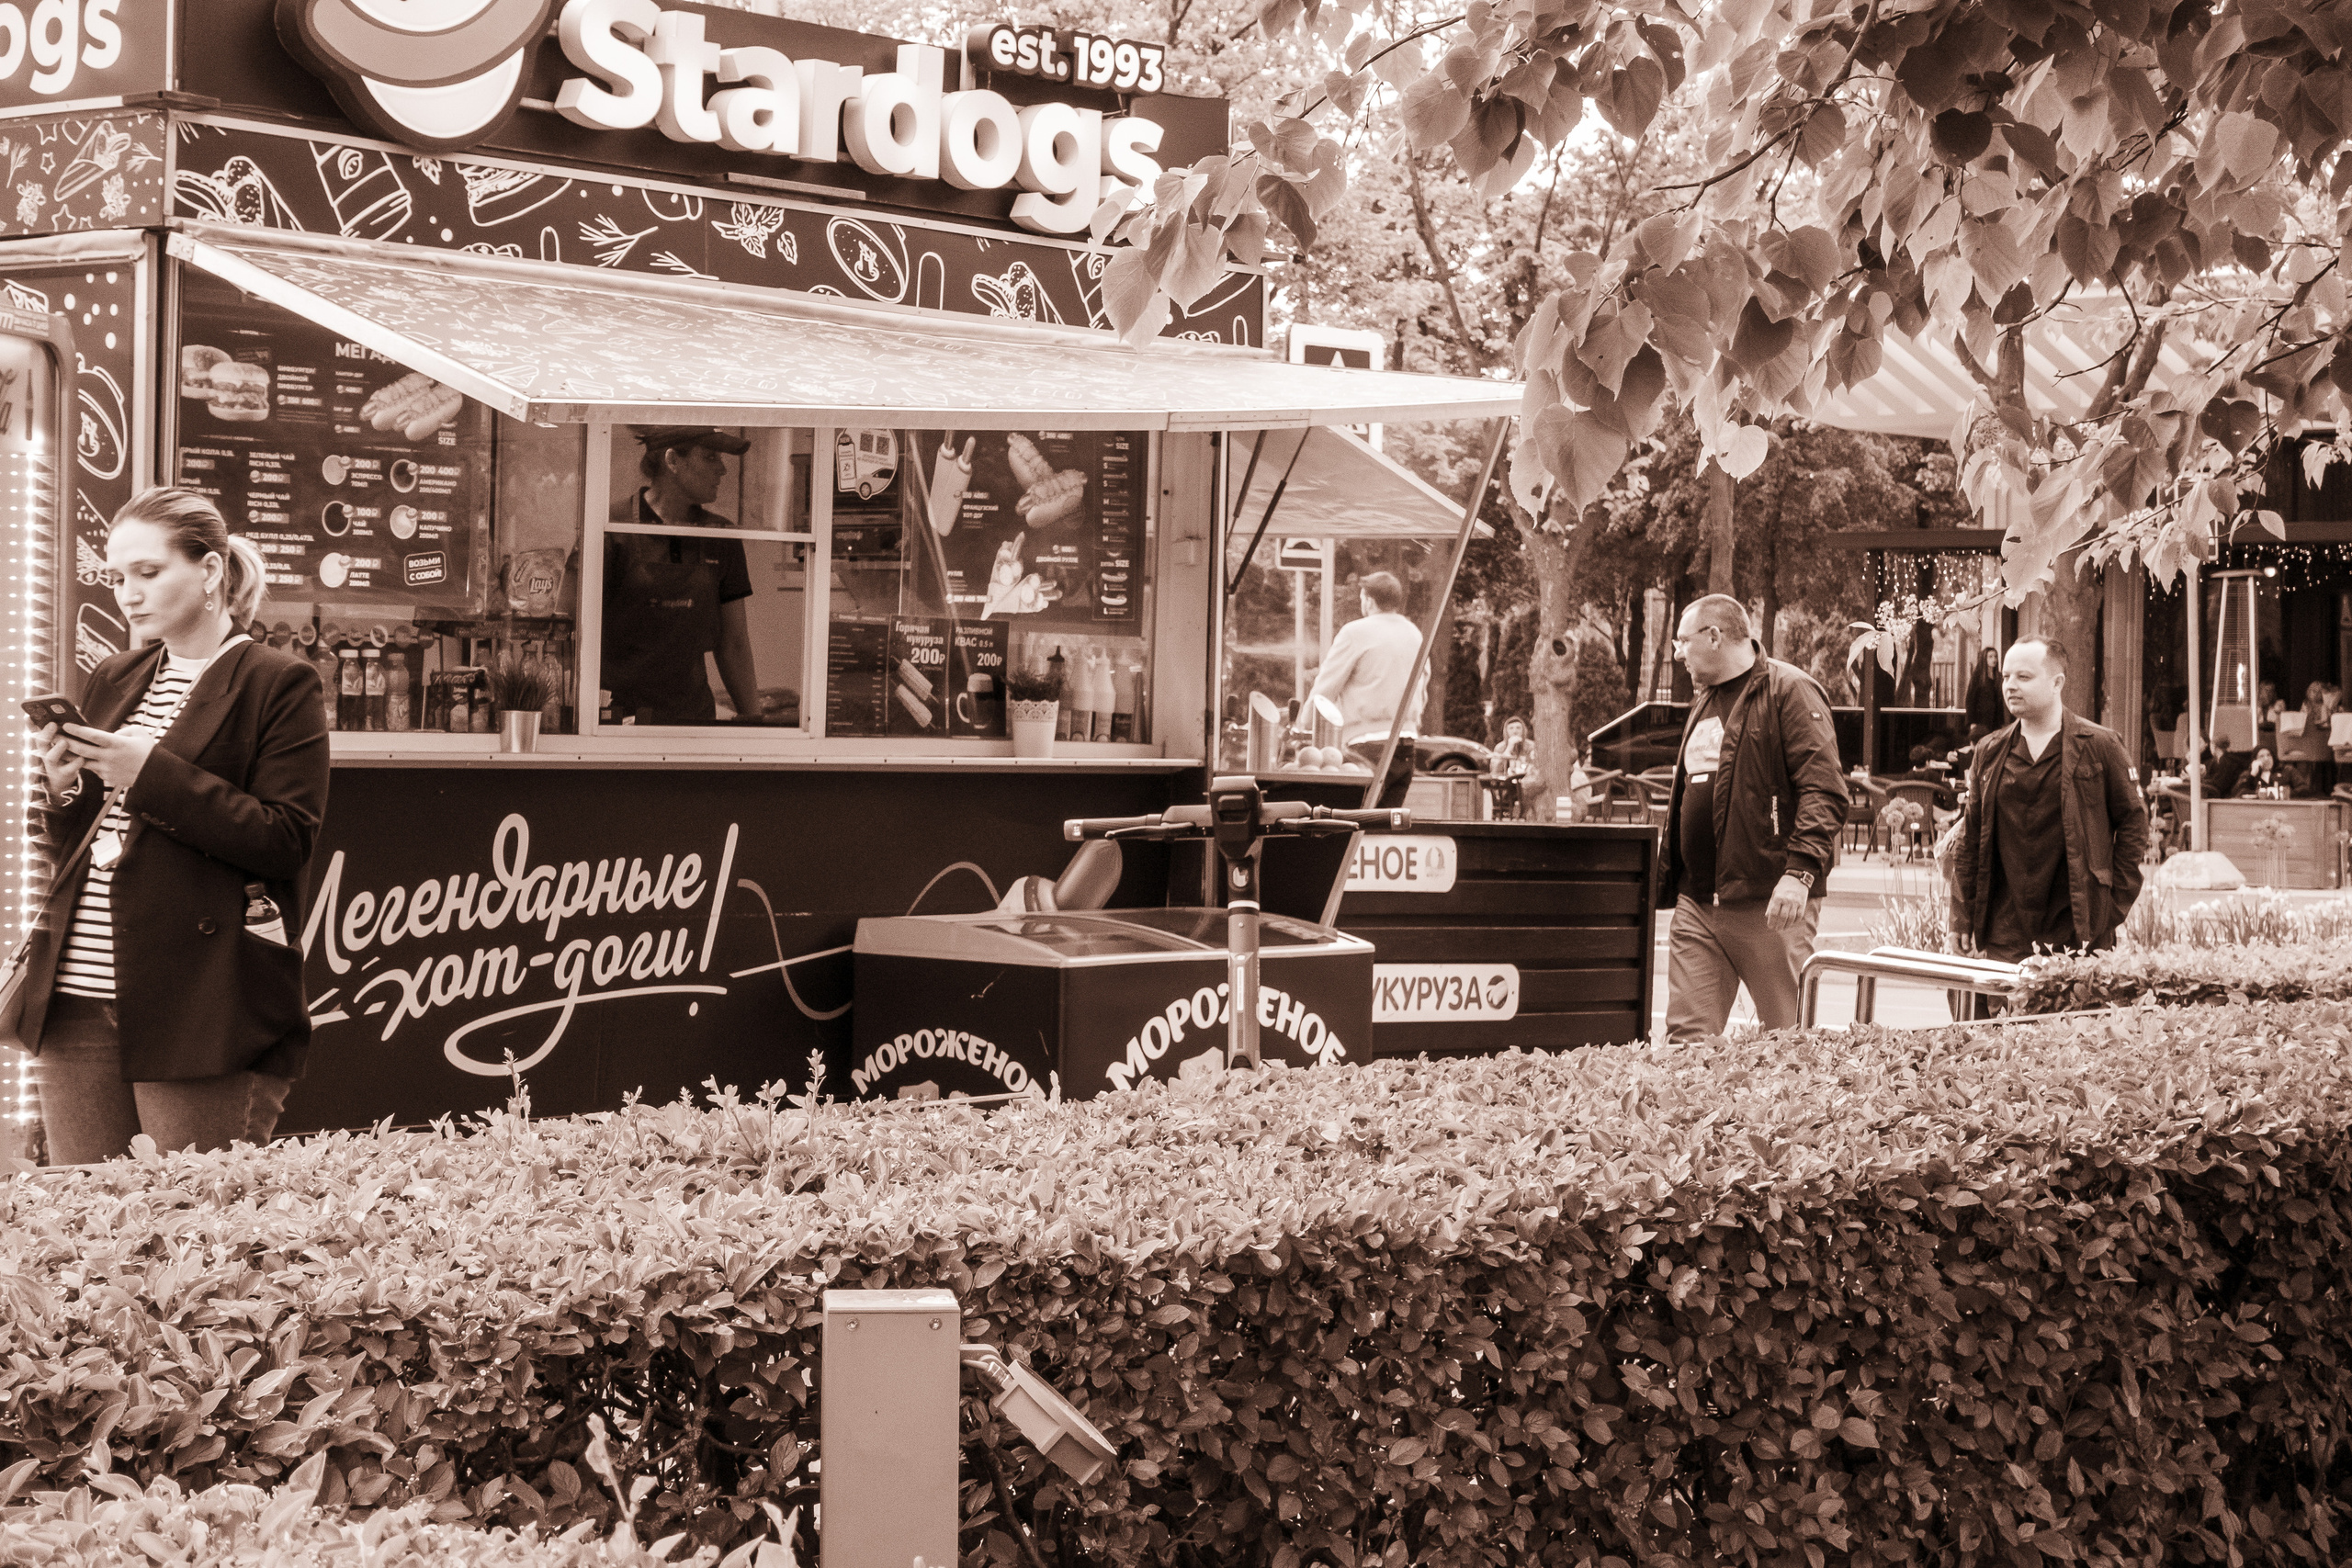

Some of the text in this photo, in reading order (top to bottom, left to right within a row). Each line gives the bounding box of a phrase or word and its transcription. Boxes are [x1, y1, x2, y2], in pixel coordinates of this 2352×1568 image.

[991, 29, 1163, 93] est. 1993
[554, 0, 1165, 234] Stardogs
[438, 437, 457, 446] SIZE
[281, 453, 295, 461] ЧАЙ
[420, 465, 435, 474] 200
[419, 479, 457, 487] АМЕРИКАНО
[276, 492, 290, 501] ЧАЙ
[419, 525, 452, 533] КАПУЧИНО
[408, 557, 441, 569] ВОЗЬМИ
[409, 572, 415, 581] С
[956, 626, 994, 636] РАЗЛИВНОЙ
[955, 637, 978, 648] КВАС
[301, 813, 707, 974] Легендарные
